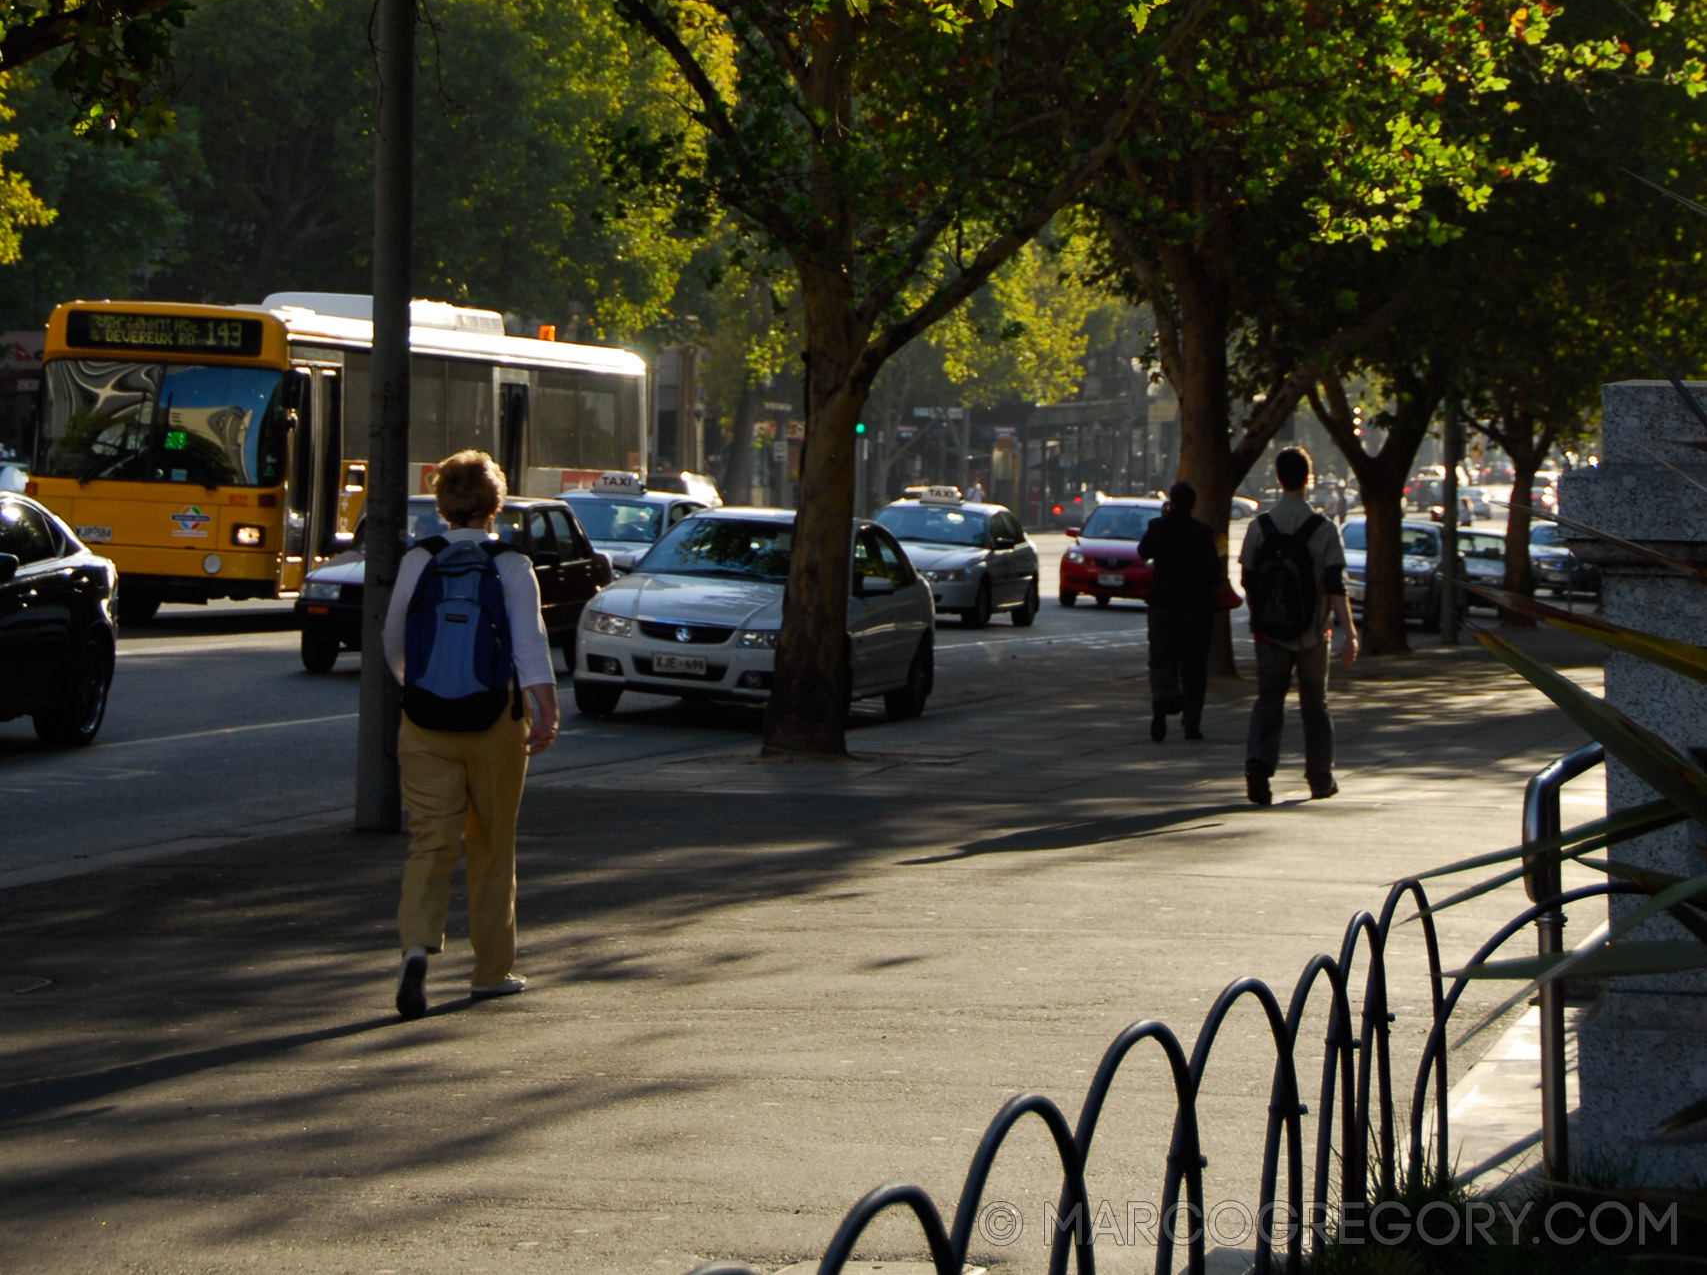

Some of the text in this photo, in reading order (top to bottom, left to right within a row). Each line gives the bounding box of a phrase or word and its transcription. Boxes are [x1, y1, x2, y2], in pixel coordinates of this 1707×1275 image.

[105, 329, 173, 346] DEVEREUX
[204, 321, 243, 347] 143
[601, 476, 632, 486] TAXI
[930, 489, 954, 498] TAXI
